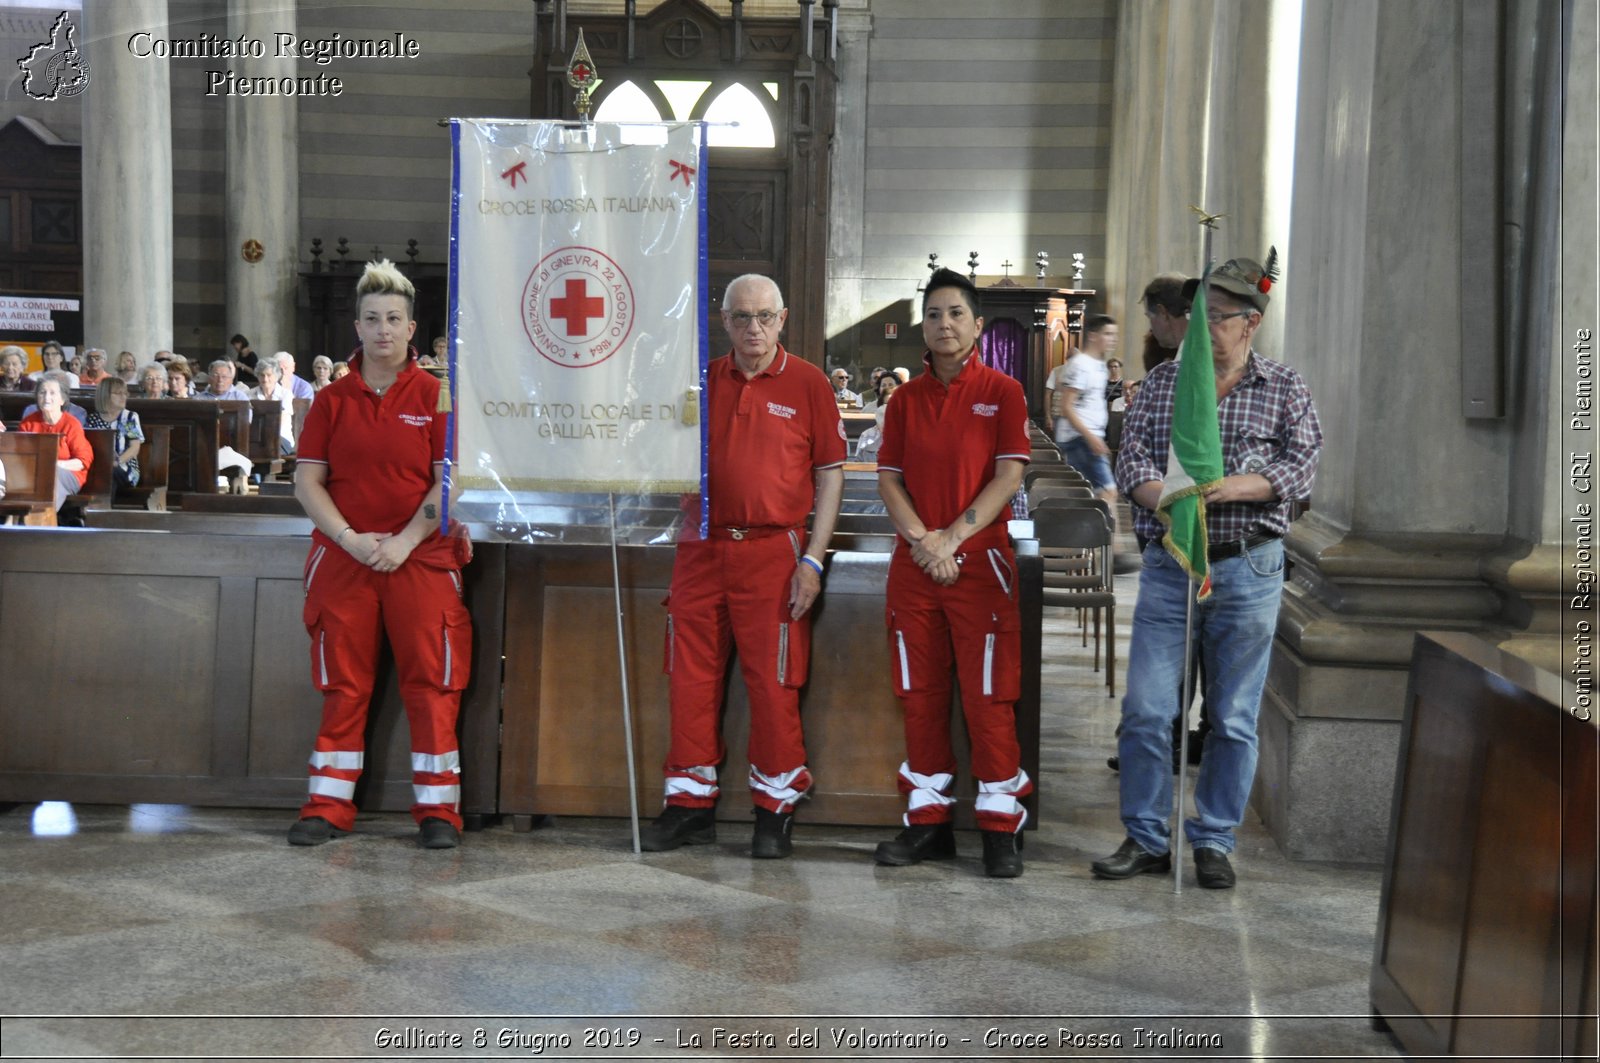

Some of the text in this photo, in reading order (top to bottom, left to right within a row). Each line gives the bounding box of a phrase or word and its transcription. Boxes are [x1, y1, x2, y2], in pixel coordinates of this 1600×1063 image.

[478, 197, 676, 216] CROCE ROSSA ITALIANA
[528, 254, 628, 358] CONVENZIONE DI GINEVRA 22 AGOSTO 1864
[10, 311, 48, 320] ABITARE
[22, 323, 54, 331] CRISTO
[483, 401, 676, 420] COMITATO LOCALE DI
[538, 424, 619, 440] GALLIATE
